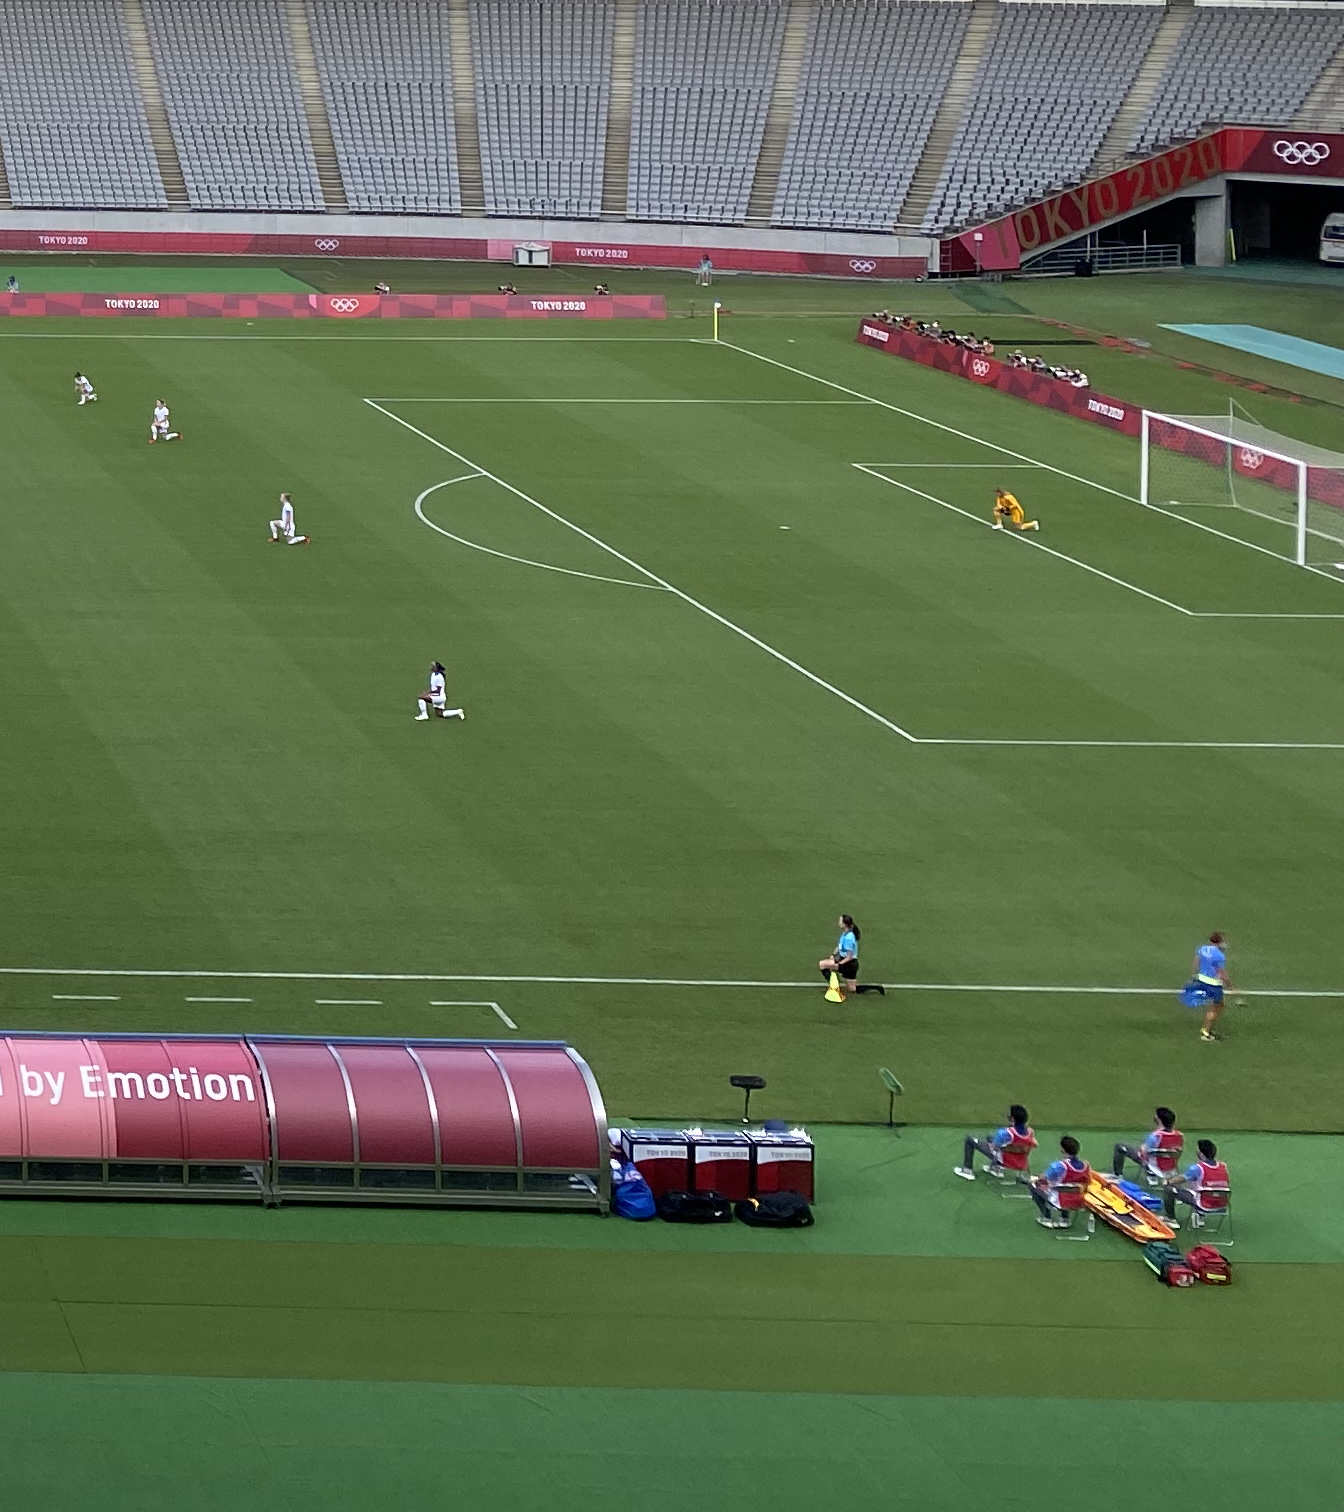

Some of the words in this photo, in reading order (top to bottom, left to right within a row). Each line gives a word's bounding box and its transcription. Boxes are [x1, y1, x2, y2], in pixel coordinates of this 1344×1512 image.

[991, 180, 1118, 259] TOKYO
[1128, 139, 1220, 207] 2020
[39, 235, 66, 244] TOKYO
[67, 236, 88, 245] 2020
[575, 247, 604, 257] TOKYO
[605, 249, 628, 258] 2020
[104, 298, 136, 309] TOKYO
[137, 299, 160, 309] 2020
[531, 300, 562, 310] TOKYO
[562, 301, 586, 311] 2020
[19, 1064, 65, 1105] by
[78, 1065, 255, 1102] Emotion
